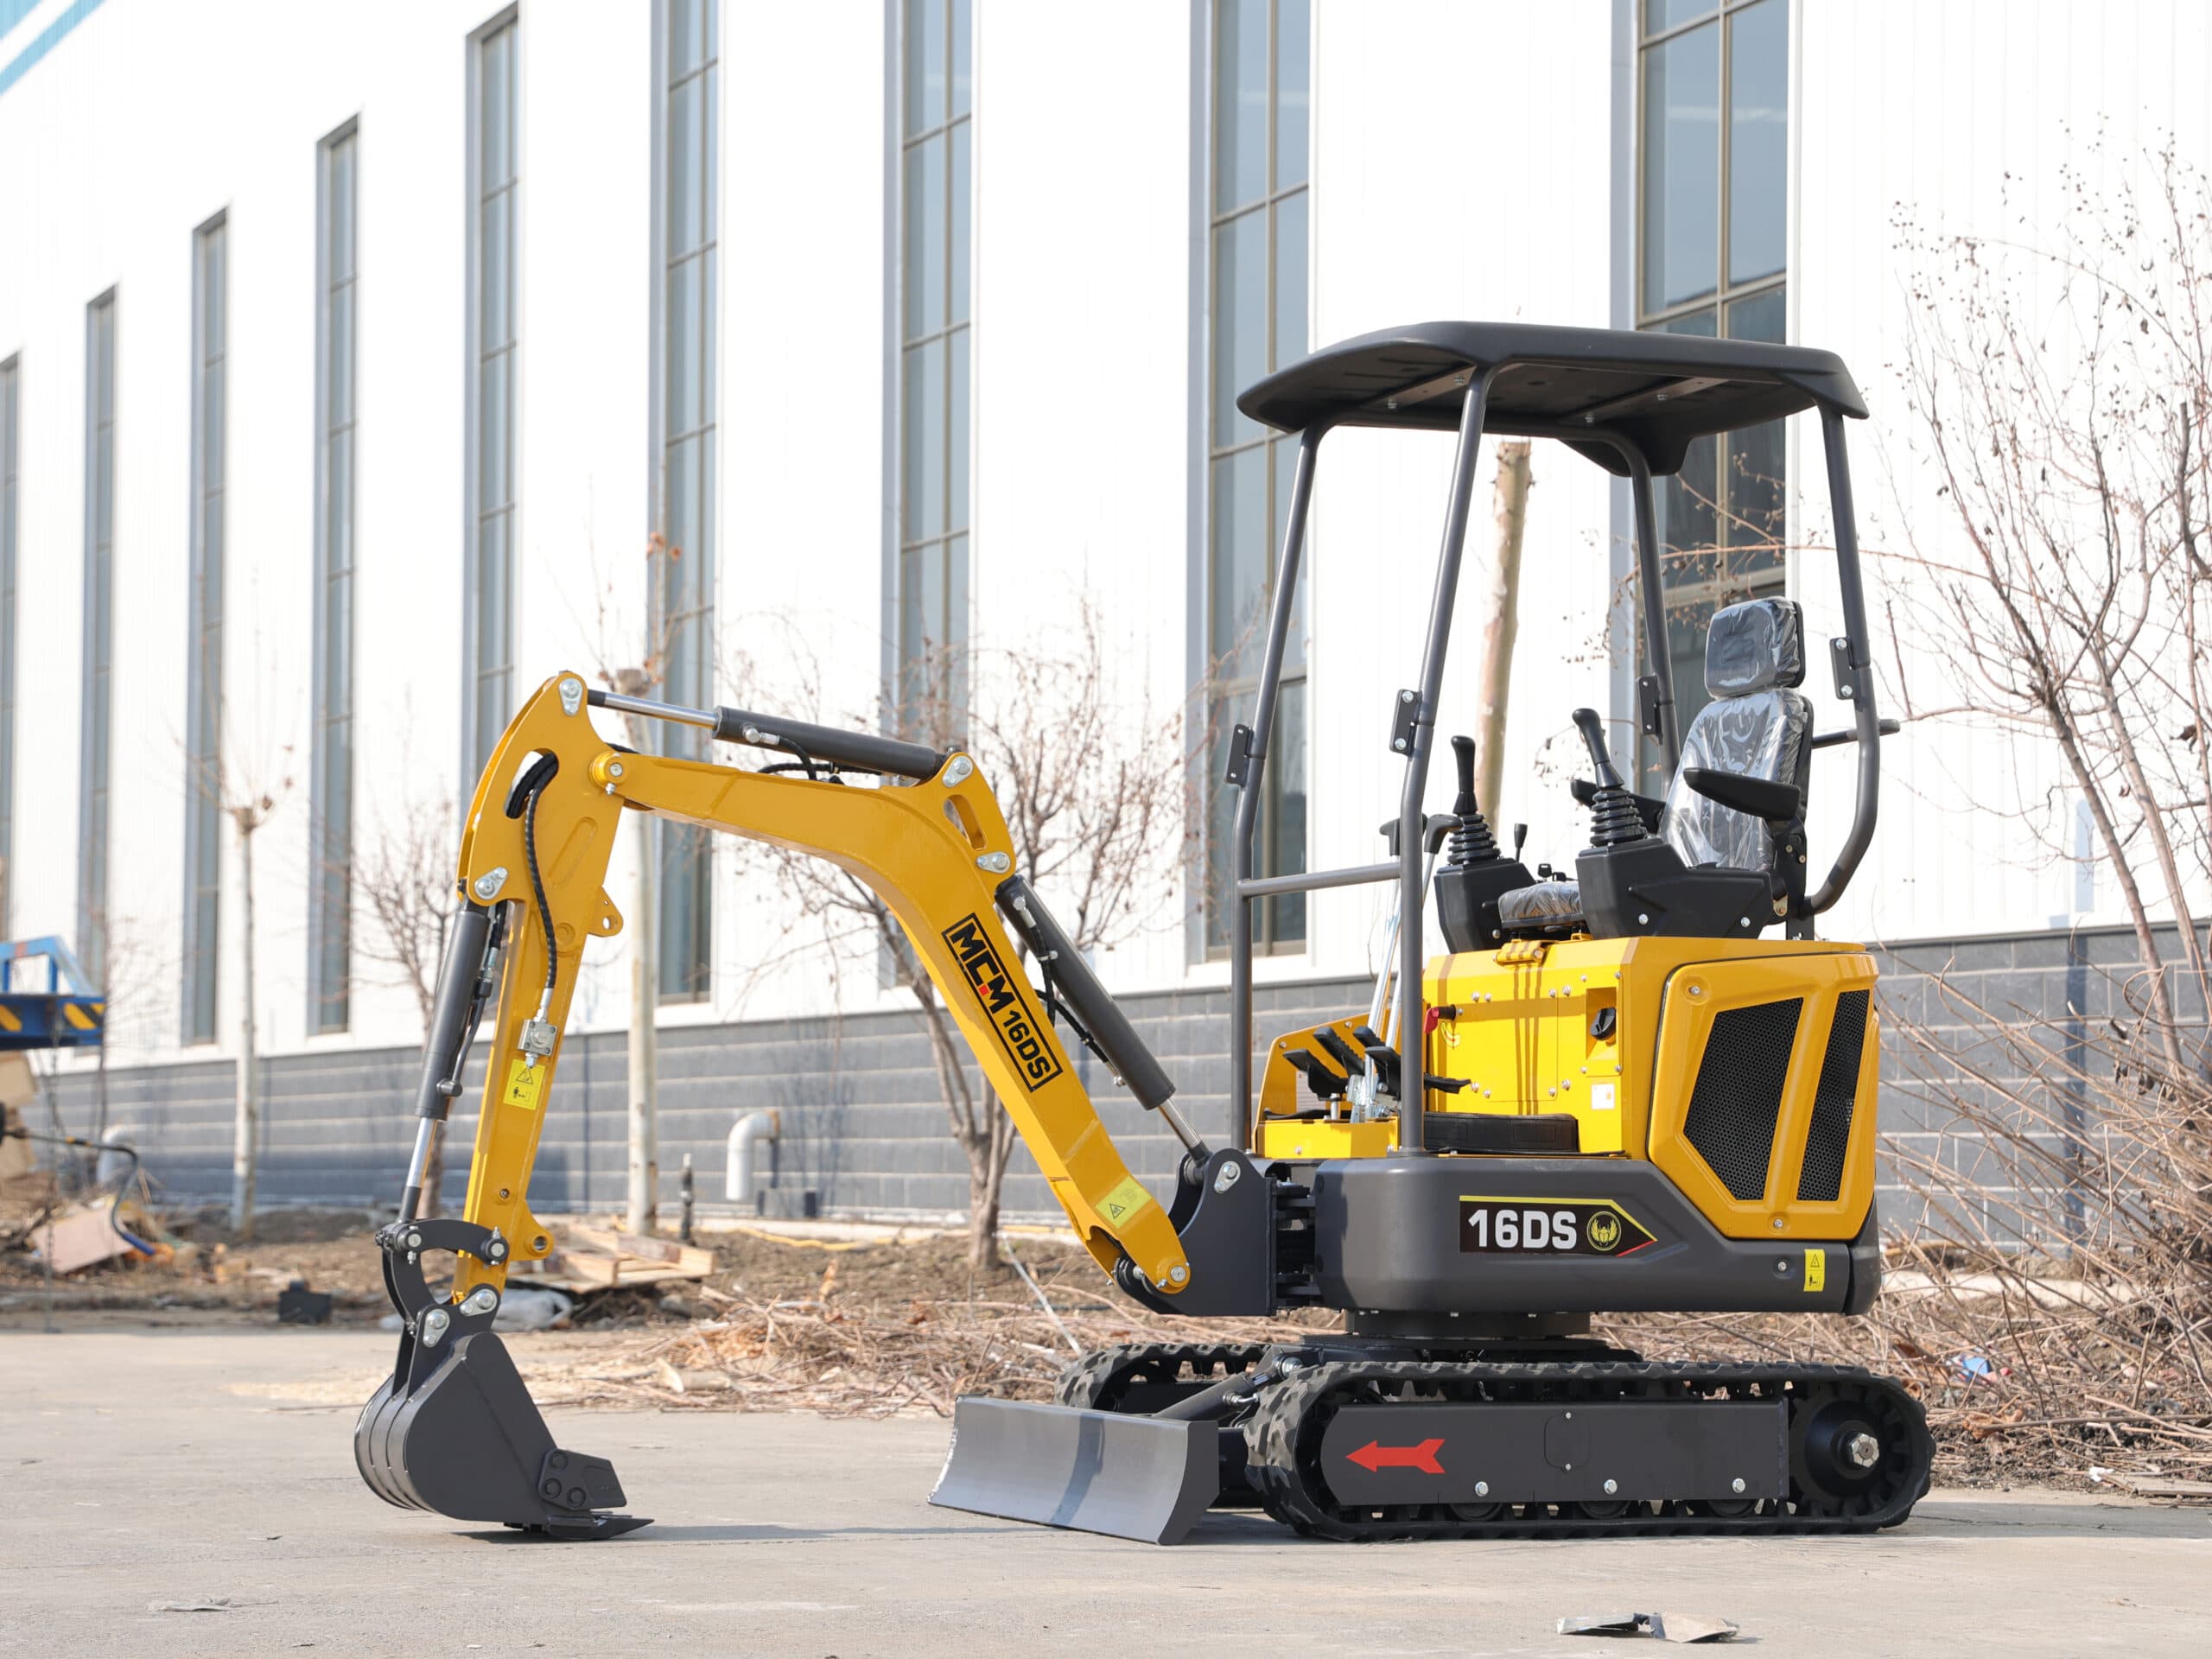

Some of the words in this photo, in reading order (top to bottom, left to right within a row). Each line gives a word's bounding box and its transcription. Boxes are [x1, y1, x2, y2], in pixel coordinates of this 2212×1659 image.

[950, 922, 1015, 1014] MCM
[1002, 1009, 1051, 1078] 16DS
[1468, 1209, 1577, 1249] 16DS
